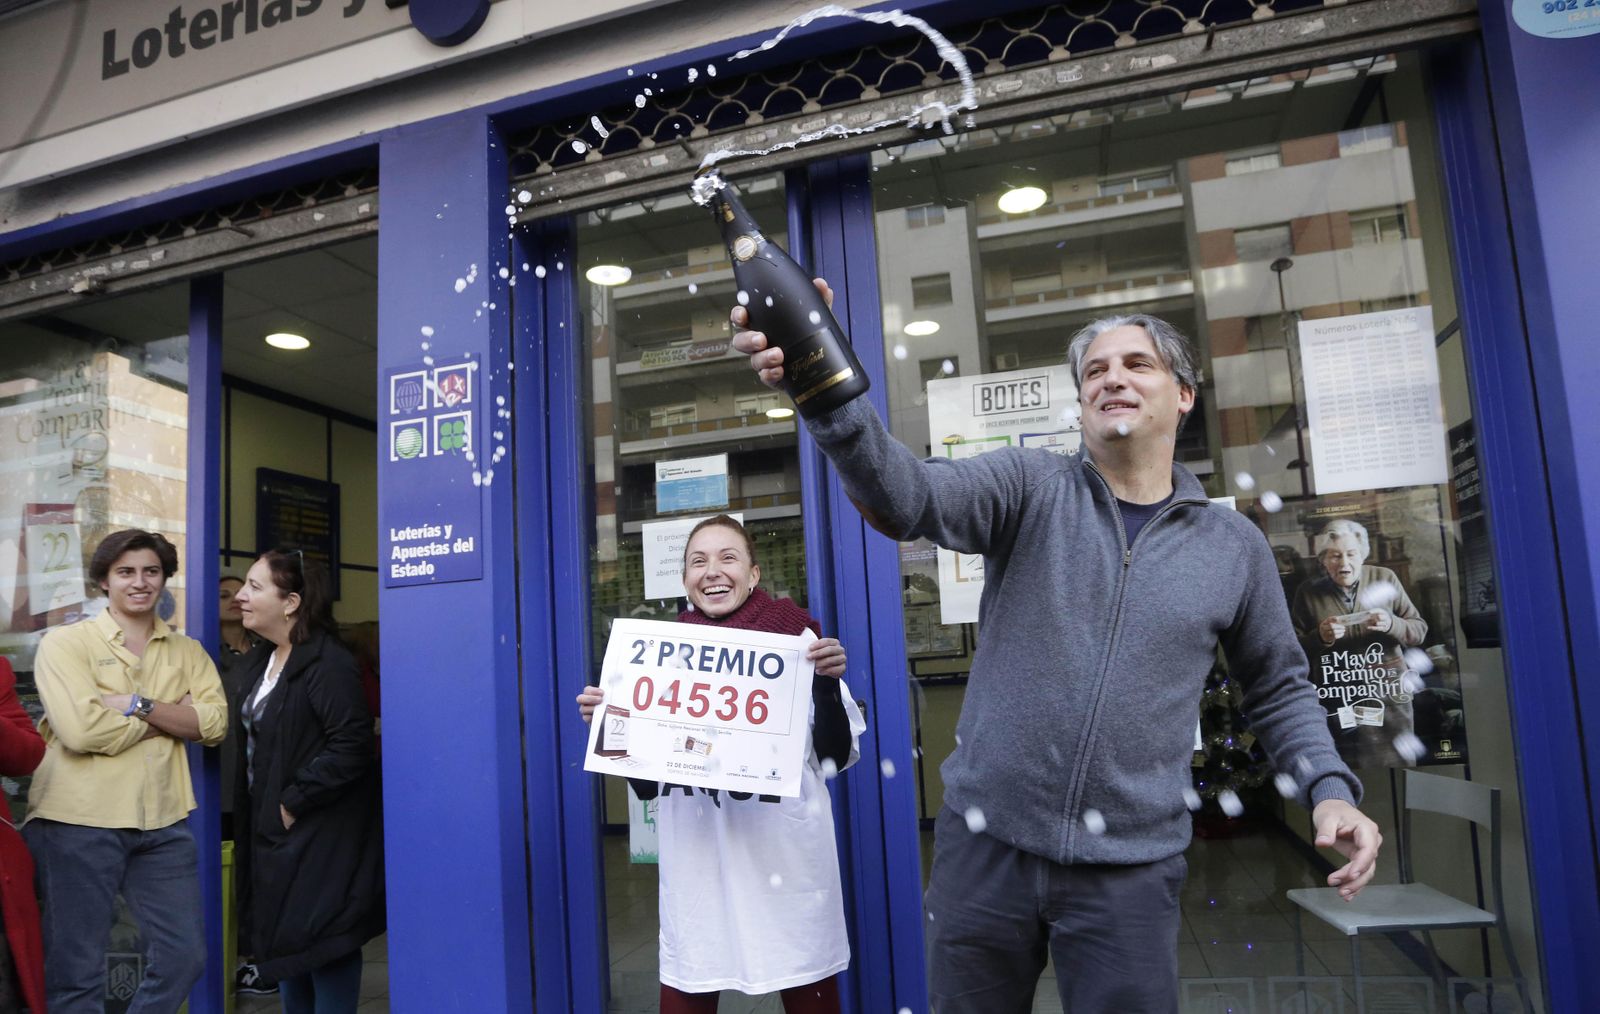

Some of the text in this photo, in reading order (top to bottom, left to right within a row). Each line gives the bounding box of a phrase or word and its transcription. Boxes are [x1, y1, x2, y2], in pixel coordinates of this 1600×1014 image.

[1542, 0, 1578, 13] 902
[981, 381, 1042, 412] BOTES
[390, 523, 453, 542] Loterías y
[391, 537, 474, 563] Apuestas del
[391, 560, 434, 578] Estado
[657, 641, 785, 679] PREMIO
[1332, 643, 1385, 670] Mayor
[1322, 665, 1386, 685] Premio
[632, 676, 769, 725] 04536
[610, 718, 626, 736] 22
